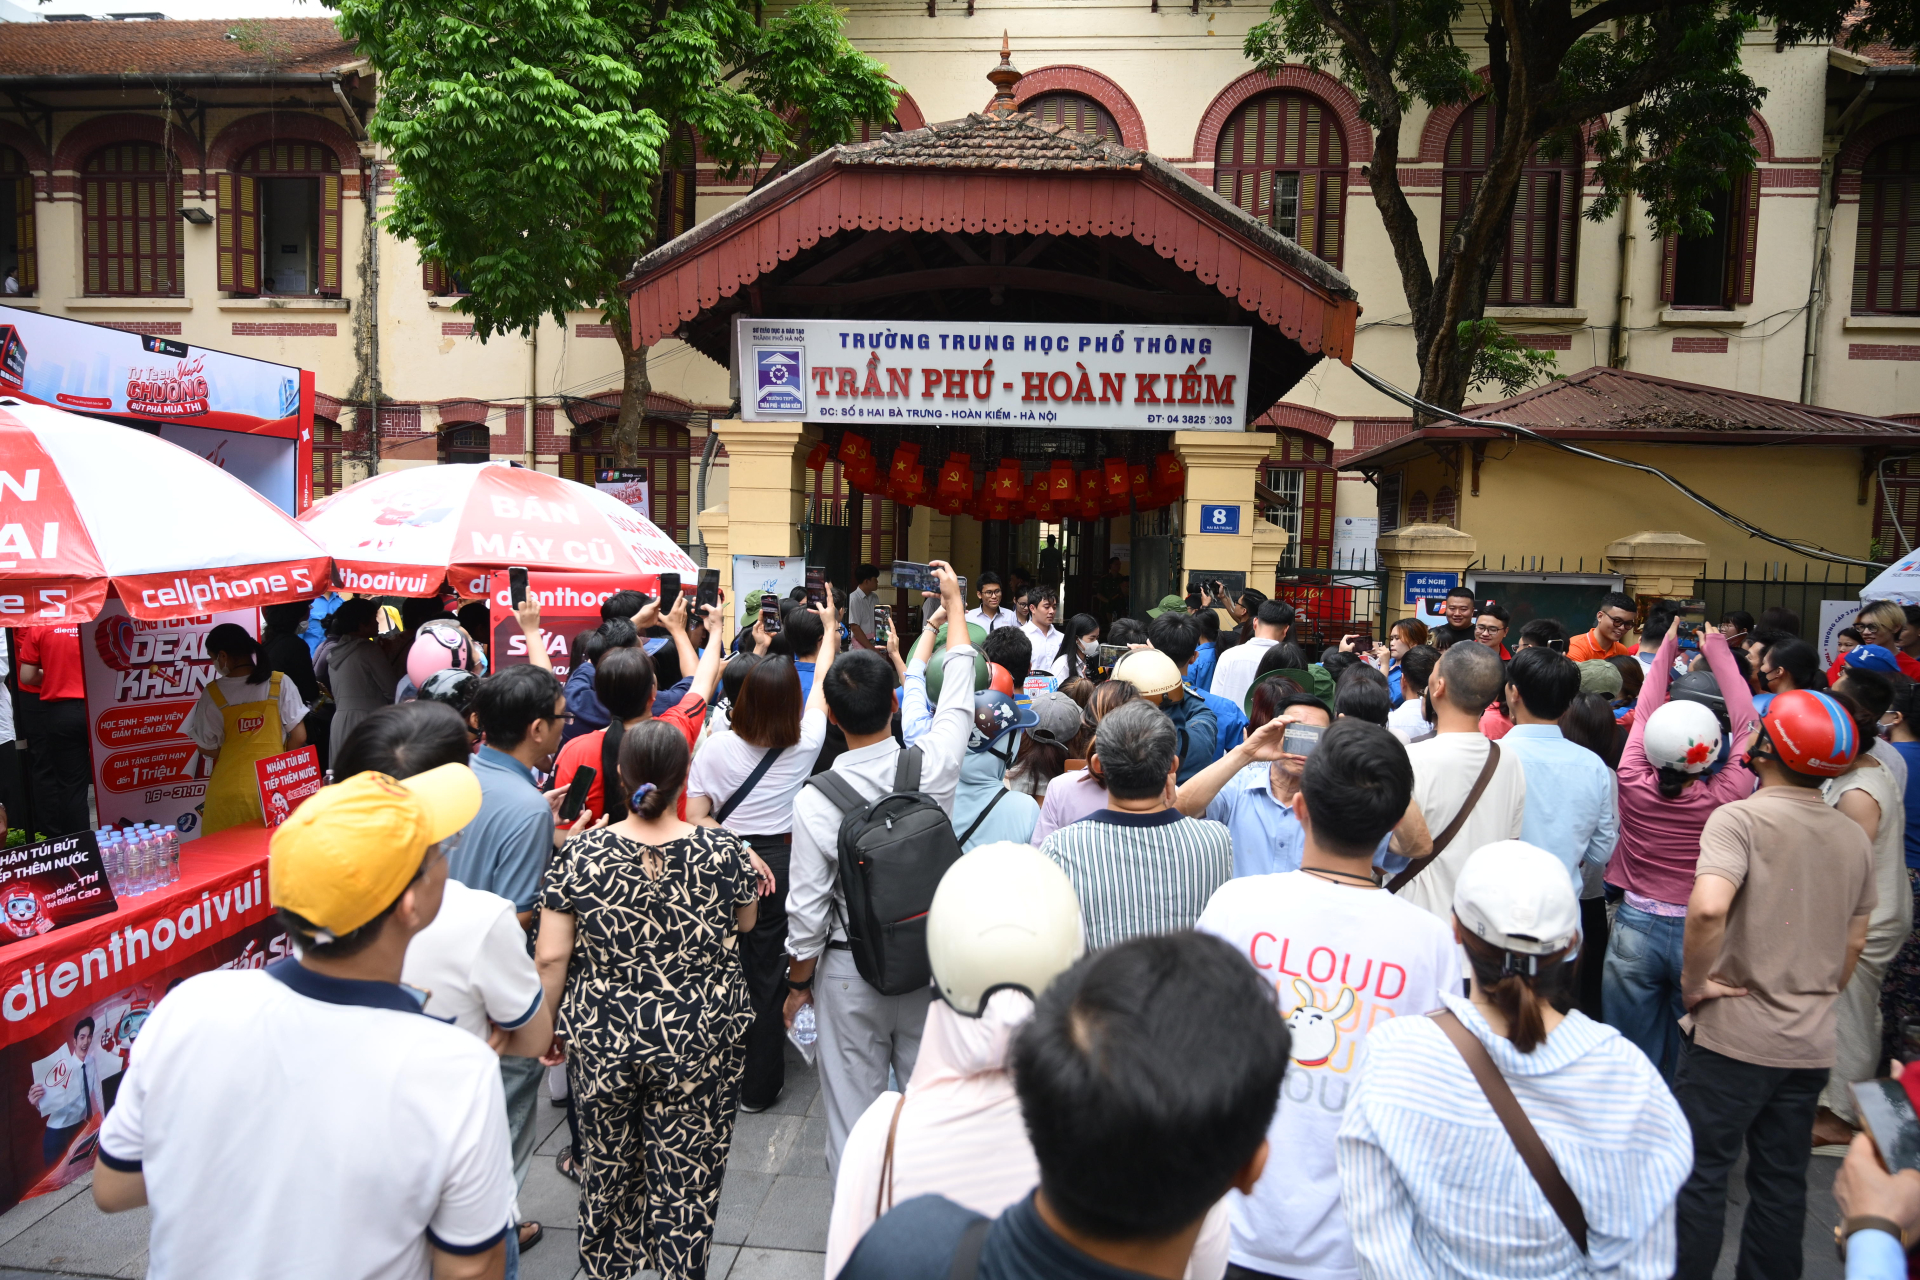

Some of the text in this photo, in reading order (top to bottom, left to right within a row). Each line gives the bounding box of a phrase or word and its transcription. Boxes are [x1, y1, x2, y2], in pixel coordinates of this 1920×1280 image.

[839, 328, 1212, 355] TRƯỜNG TRUNG HỌC PHỔ THÔNG
[812, 351, 912, 398] TRẦN
[921, 358, 995, 400] PHÚ
[1021, 361, 1126, 403] HOÀN
[1134, 357, 1236, 405] KIẾM
[164, 402, 183, 413] MÙA
[185, 402, 201, 411] THI
[820, 407, 837, 416] ĐC:
[841, 404, 856, 417] SỐ
[859, 408, 864, 417] 8
[867, 408, 885, 417] HAI
[889, 406, 904, 418] BÀ
[907, 409, 943, 419] TRƯNG
[952, 407, 982, 419] HOÀN
[985, 408, 1010, 420] KIẾM
[1020, 409, 1035, 421] HÀ
[1038, 410, 1057, 423] NỘI
[1167, 415, 1179, 424] 04
[1182, 415, 1206, 424] 3825
[602, 470, 620, 481] FPT
[490, 495, 580, 525] BÁN
[1213, 508, 1226, 524] 8
[471, 531, 615, 566] MÁY CŨ
[1150, 684, 1174, 693] HONDA
[100, 720, 117, 730] HỌC
[118, 718, 137, 726] SINH
[144, 715, 162, 723] SINH
[164, 711, 184, 721] VIÊN
[111, 721, 172, 739] GIẢM THÊM ĐẾN
[114, 752, 186, 769] QUÀ TẶNG GIỚI HẠN
[266, 750, 310, 774] NHẬN TÚI BÚT
[133, 768, 139, 785] 1
[142, 765, 177, 780] Triệu
[264, 765, 317, 791] TIẾP THÊM NƯỚC
[145, 790, 162, 804] 1.6
[172, 784, 206, 799] 31.10
[0, 838, 79, 866] HẬN TÚI BÚT
[14, 861, 52, 879] THÊM
[55, 851, 90, 869] NƯỚC
[57, 892, 76, 906] Điểm
[77, 887, 101, 900] Cao
[2, 869, 262, 1022] dienthoaivui
[1250, 932, 1406, 1000] CLOUD
[53, 1063, 67, 1082] 10
